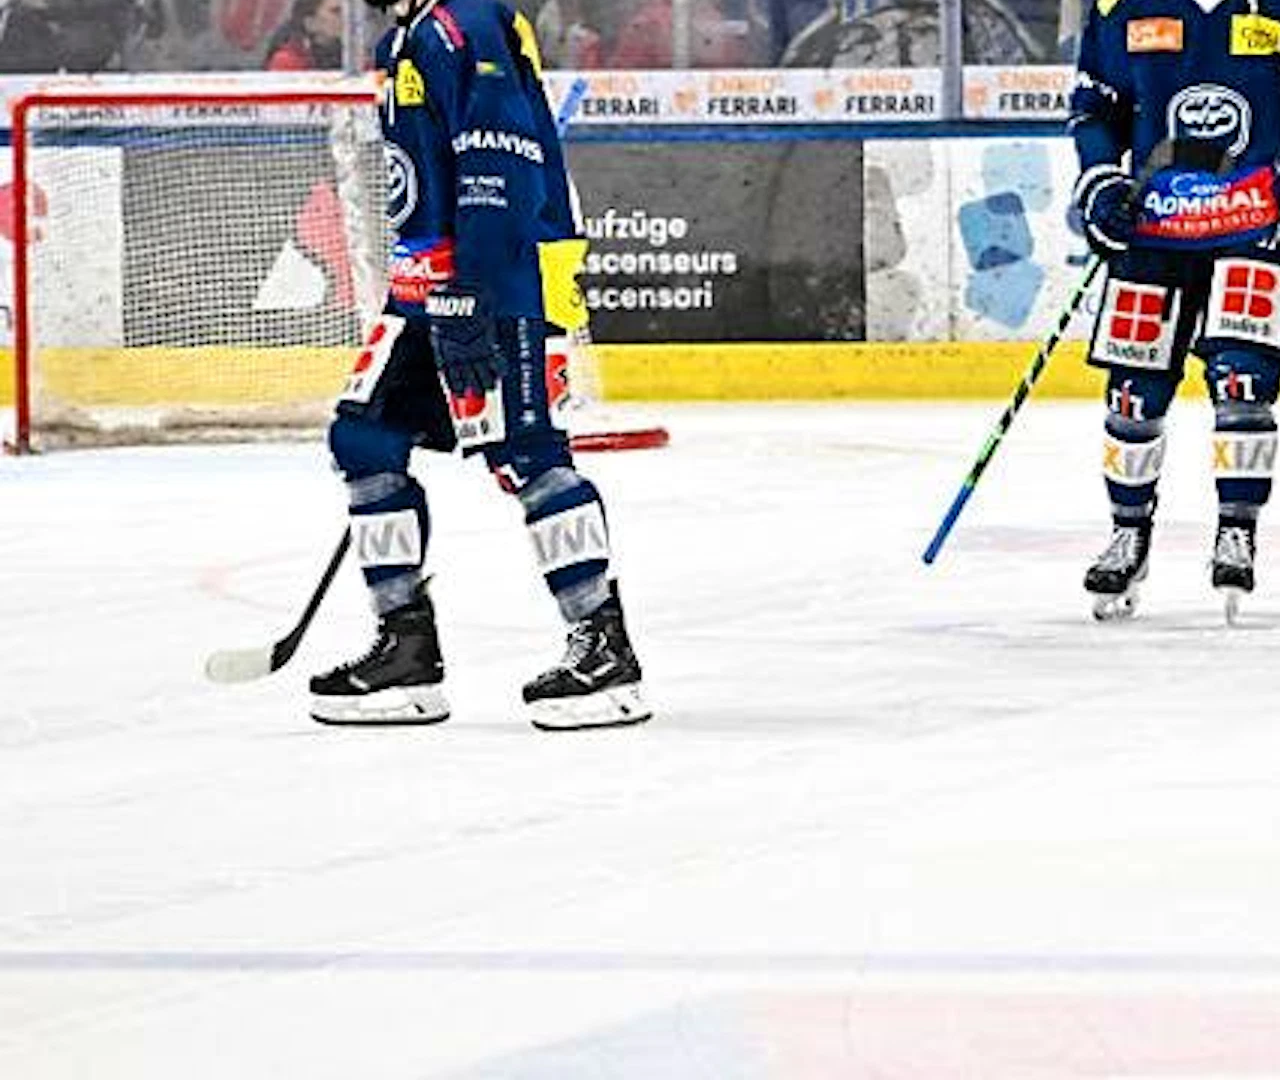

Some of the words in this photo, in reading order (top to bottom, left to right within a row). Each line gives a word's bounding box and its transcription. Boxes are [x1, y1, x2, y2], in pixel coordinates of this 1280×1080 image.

[582, 97, 659, 115] ERRARI
[706, 96, 796, 116] FERRARI
[844, 95, 935, 114] FERRARI
[998, 93, 1066, 112] FERRA
[1144, 187, 1268, 217] ADMIRAL
[584, 208, 689, 247] ufzüge
[586, 250, 738, 276] scenseurs
[585, 280, 714, 310] scensori
